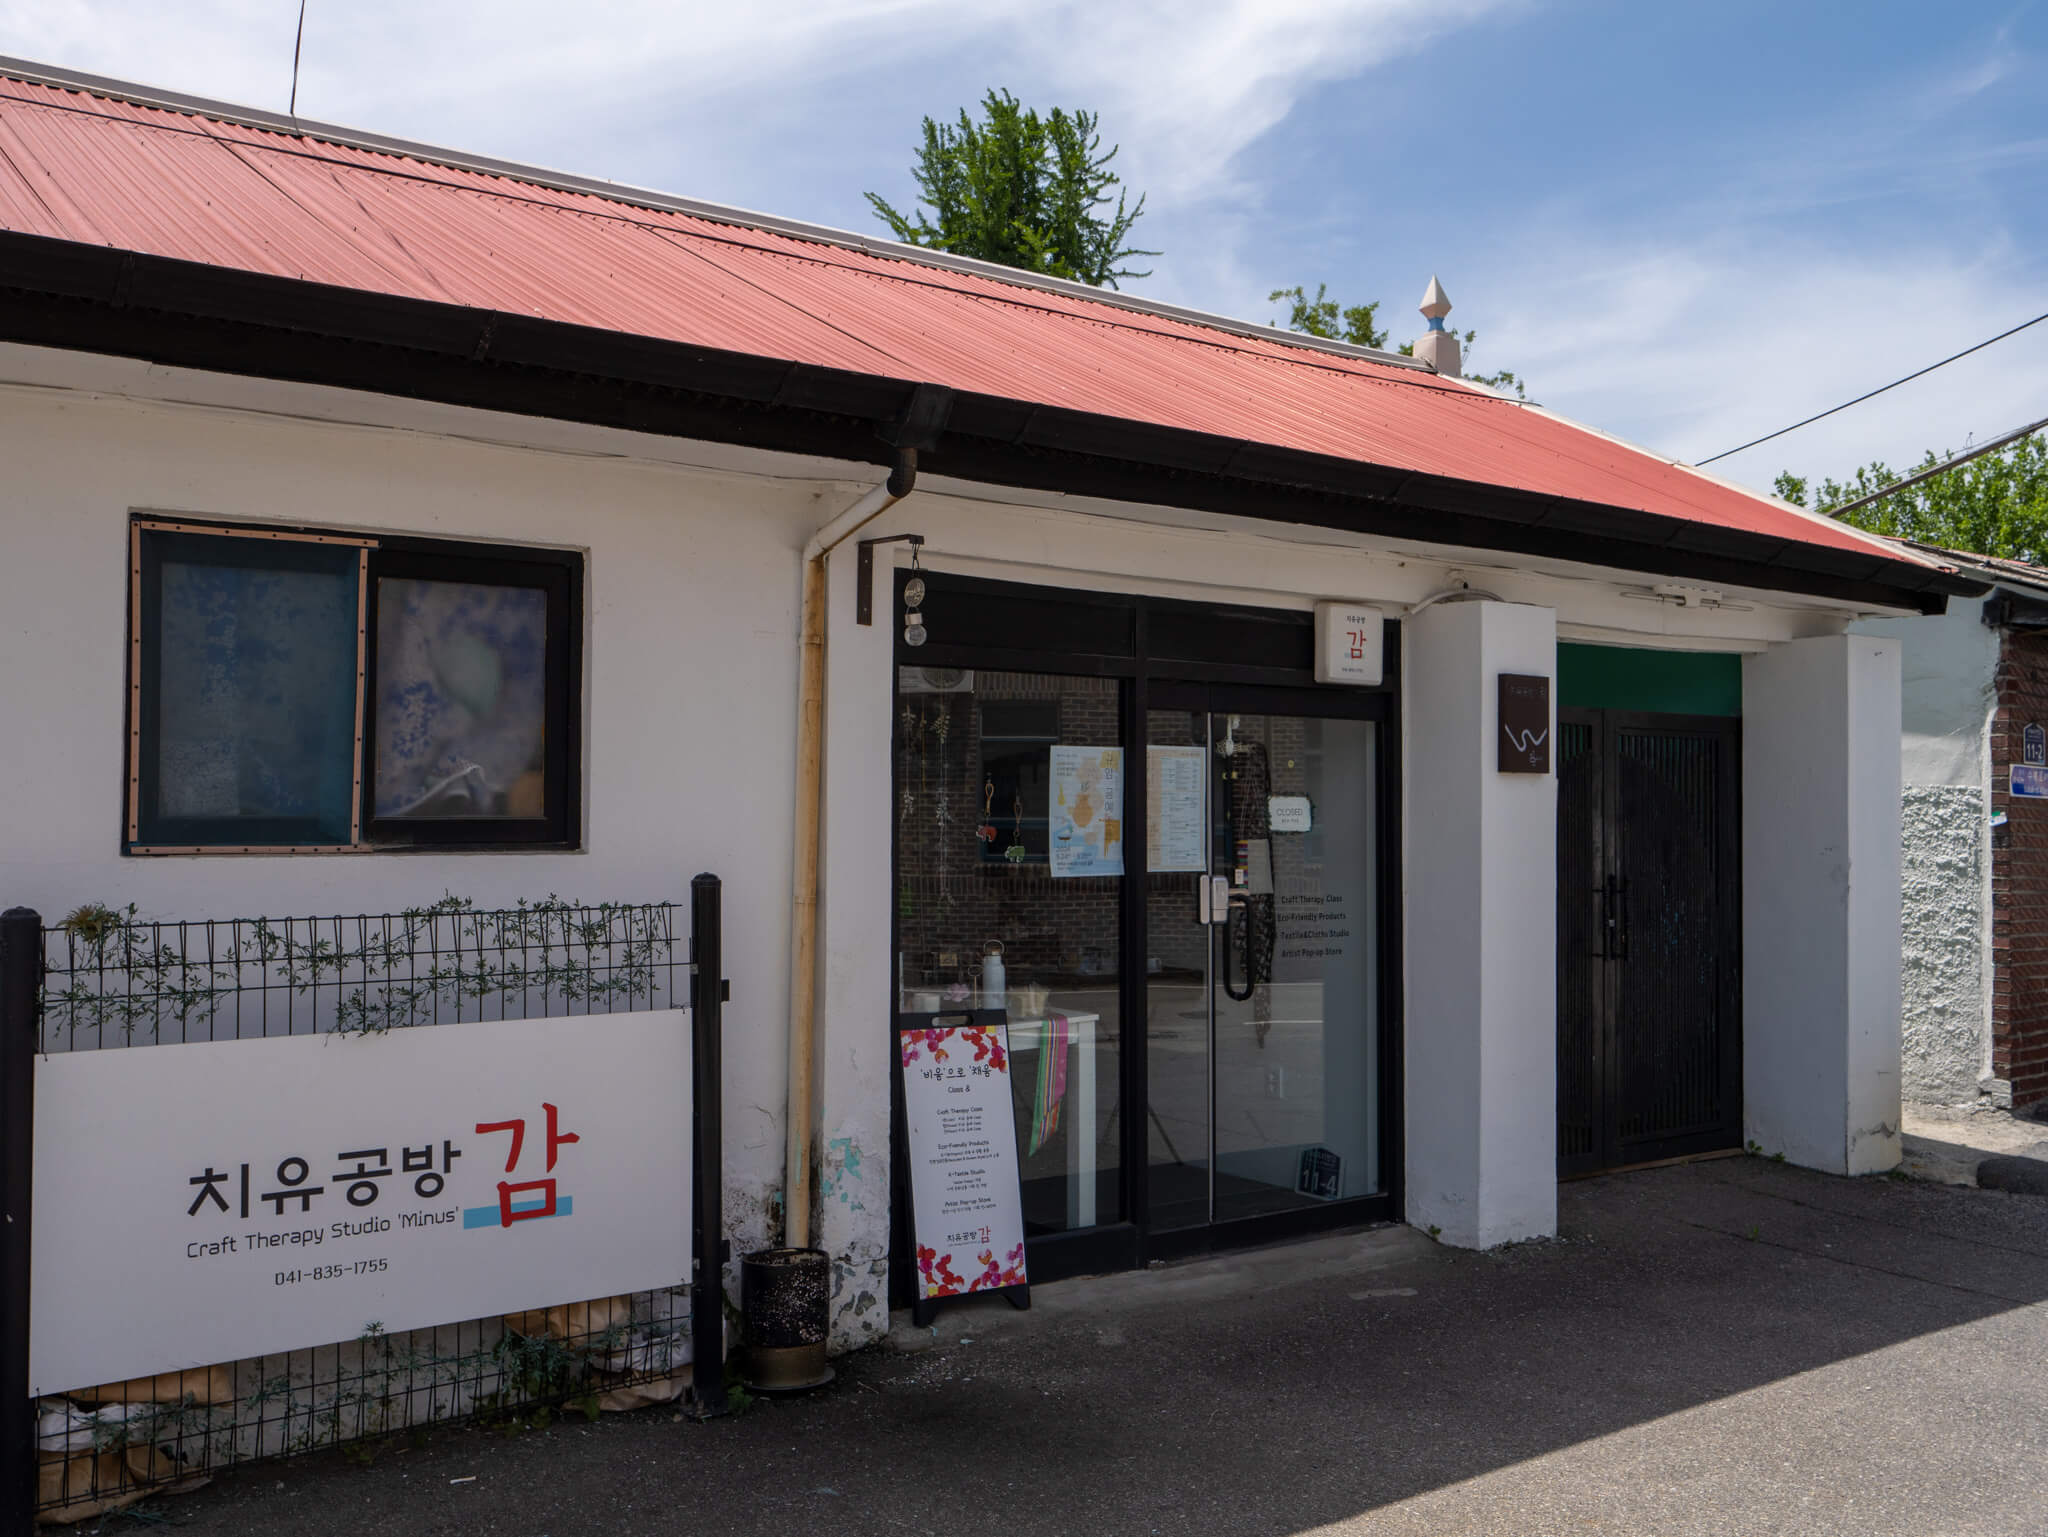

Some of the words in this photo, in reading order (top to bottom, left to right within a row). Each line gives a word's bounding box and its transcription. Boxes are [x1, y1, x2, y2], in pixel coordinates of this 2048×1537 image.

[1346, 629, 1368, 659] 감
[1276, 808, 1303, 816] CLOSED
[1281, 896, 1298, 904] Craft
[1299, 895, 1324, 905] Therapy
[1326, 894, 1343, 902] Class
[1277, 912, 1317, 922] Eco-Friendly
[1319, 911, 1346, 920] Products
[1329, 929, 1350, 938] Studio
[1282, 950, 1300, 958] Artist
[1302, 948, 1324, 958] Pop-up
[1325, 947, 1342, 956] Store
[187, 1140, 462, 1218] 치유공방
[475, 1102, 580, 1228] 감
[1304, 1169, 1336, 1193] 11-4
[187, 1236, 237, 1258] Craft
[245, 1228, 324, 1250] Therapy
[331, 1216, 391, 1238] Studio
[398, 1206, 459, 1229] 'Minus'
[978, 1225, 991, 1244] 감
[275, 1258, 388, 1286] 041-835-1755
